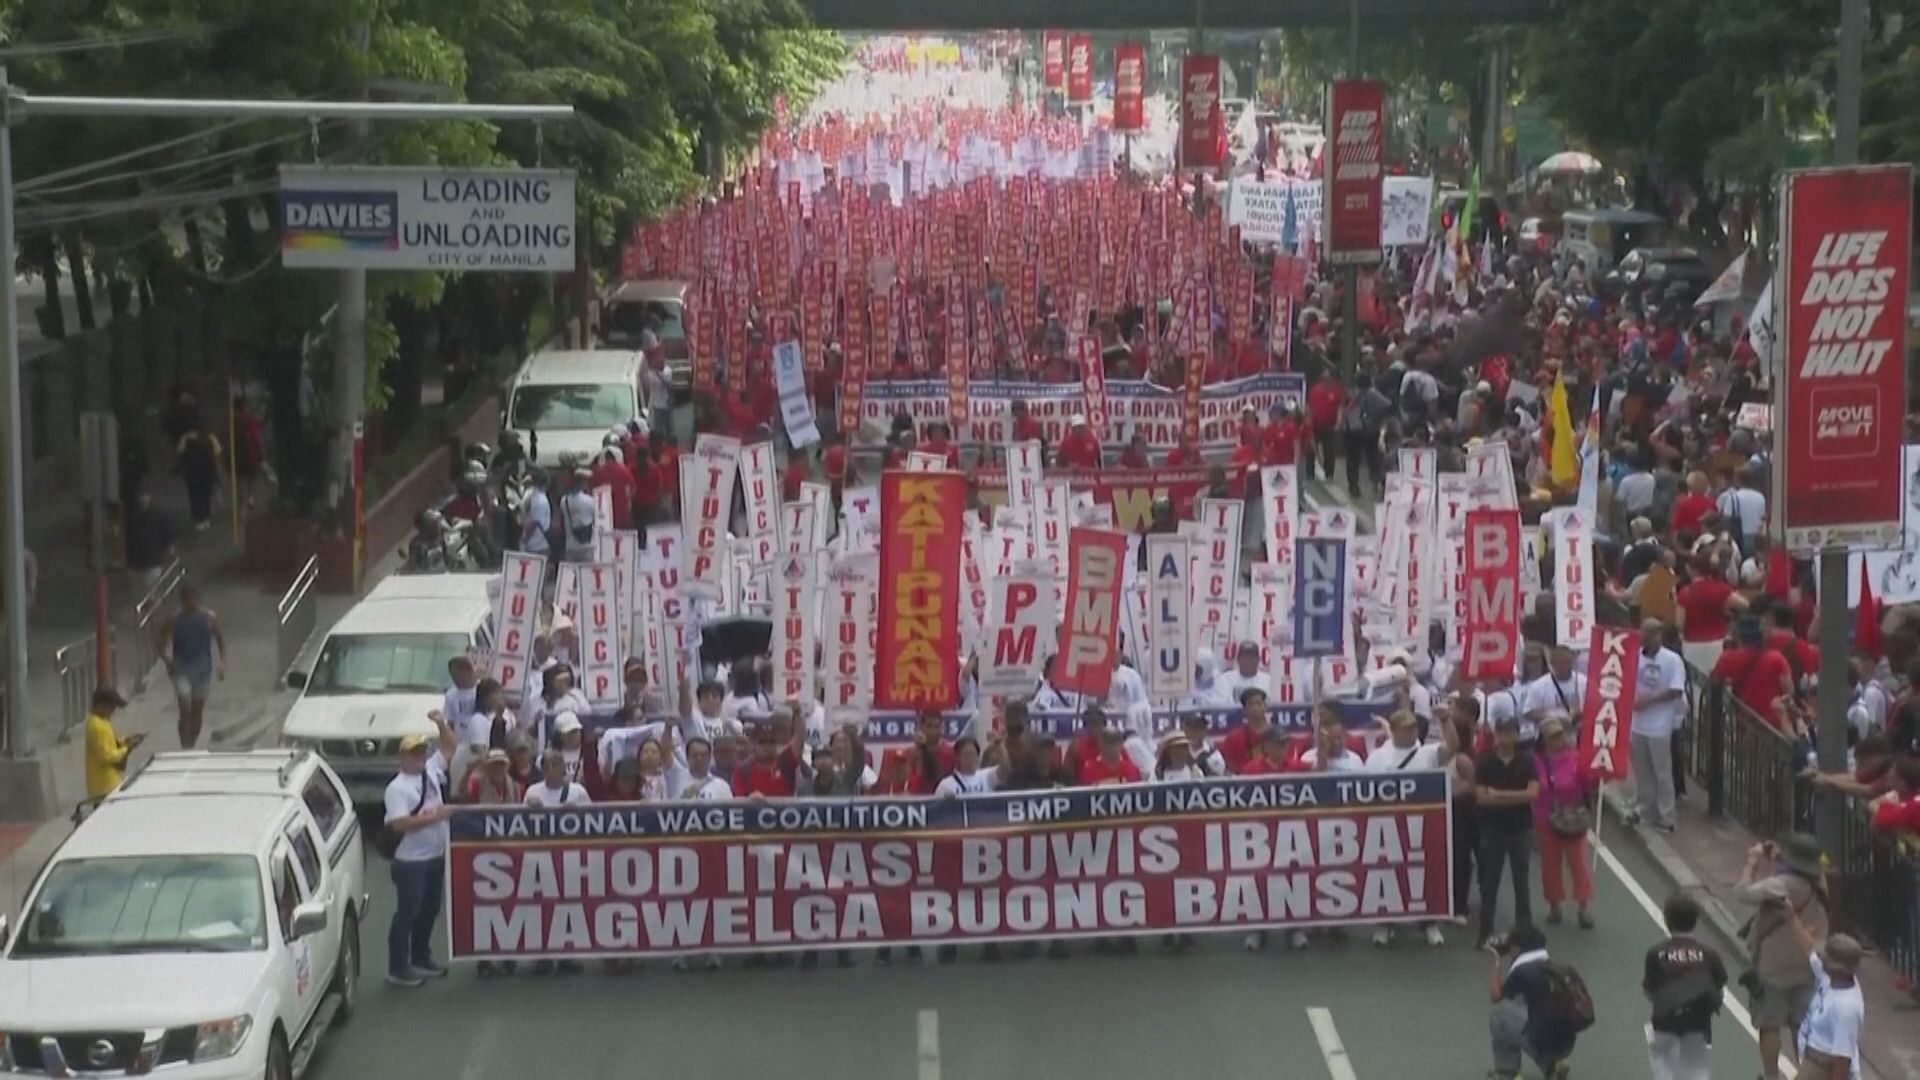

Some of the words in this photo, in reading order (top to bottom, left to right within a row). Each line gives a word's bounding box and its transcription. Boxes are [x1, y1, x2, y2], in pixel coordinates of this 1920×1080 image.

[286, 203, 392, 228] DAVIES
[422, 178, 551, 204] LOADING
[470, 207, 505, 220] AND
[403, 222, 571, 248] UNLOADING
[428, 253, 460, 265] CITY
[467, 253, 485, 265] OF
[490, 253, 547, 266] MANILA
[1811, 230, 1889, 269] LIFE
[1800, 266, 1897, 306] DOES
[1808, 303, 1885, 342] NOT
[1083, 339, 1104, 427] PTGWO
[1800, 340, 1894, 378] WAIT
[1817, 405, 1873, 423] MOVE
[694, 467, 721, 580] TUCP
[751, 447, 770, 562] TUCP
[1273, 495, 1291, 564] TUC
[656, 535, 681, 619] TUC
[895, 479, 944, 686] KATIPUNAN
[1065, 544, 1118, 679] BMP
[1158, 552, 1180, 674] ALU
[1303, 543, 1337, 650] NCL
[1407, 532, 1418, 637] TUCP
[1468, 522, 1515, 678] BMP
[1566, 537, 1584, 638] TUCP
[502, 559, 531, 688] TUCP
[592, 566, 609, 699] TUCP
[785, 587, 802, 696] TUCP
[839, 590, 857, 705] TUCP
[994, 582, 1038, 667] PM
[1590, 632, 1628, 770] KASAMA
[484, 810, 645, 836] NATIONAL
[658, 807, 745, 832] WAGE
[758, 804, 928, 830] COALITION
[1007, 798, 1072, 821] BMP
[1090, 794, 1155, 817] KMU
[1165, 783, 1318, 811] NAGKAISA
[1336, 779, 1417, 804] TUCP
[472, 847, 700, 900] SAHOD
[726, 841, 936, 895] ITAAS!
[961, 825, 1180, 884] BUWIS
[1204, 815, 1425, 871] IBABA!
[472, 897, 884, 953] MAGWELGA
[911, 878, 1147, 936] BUONG
[1172, 867, 1427, 925] BANSA!
